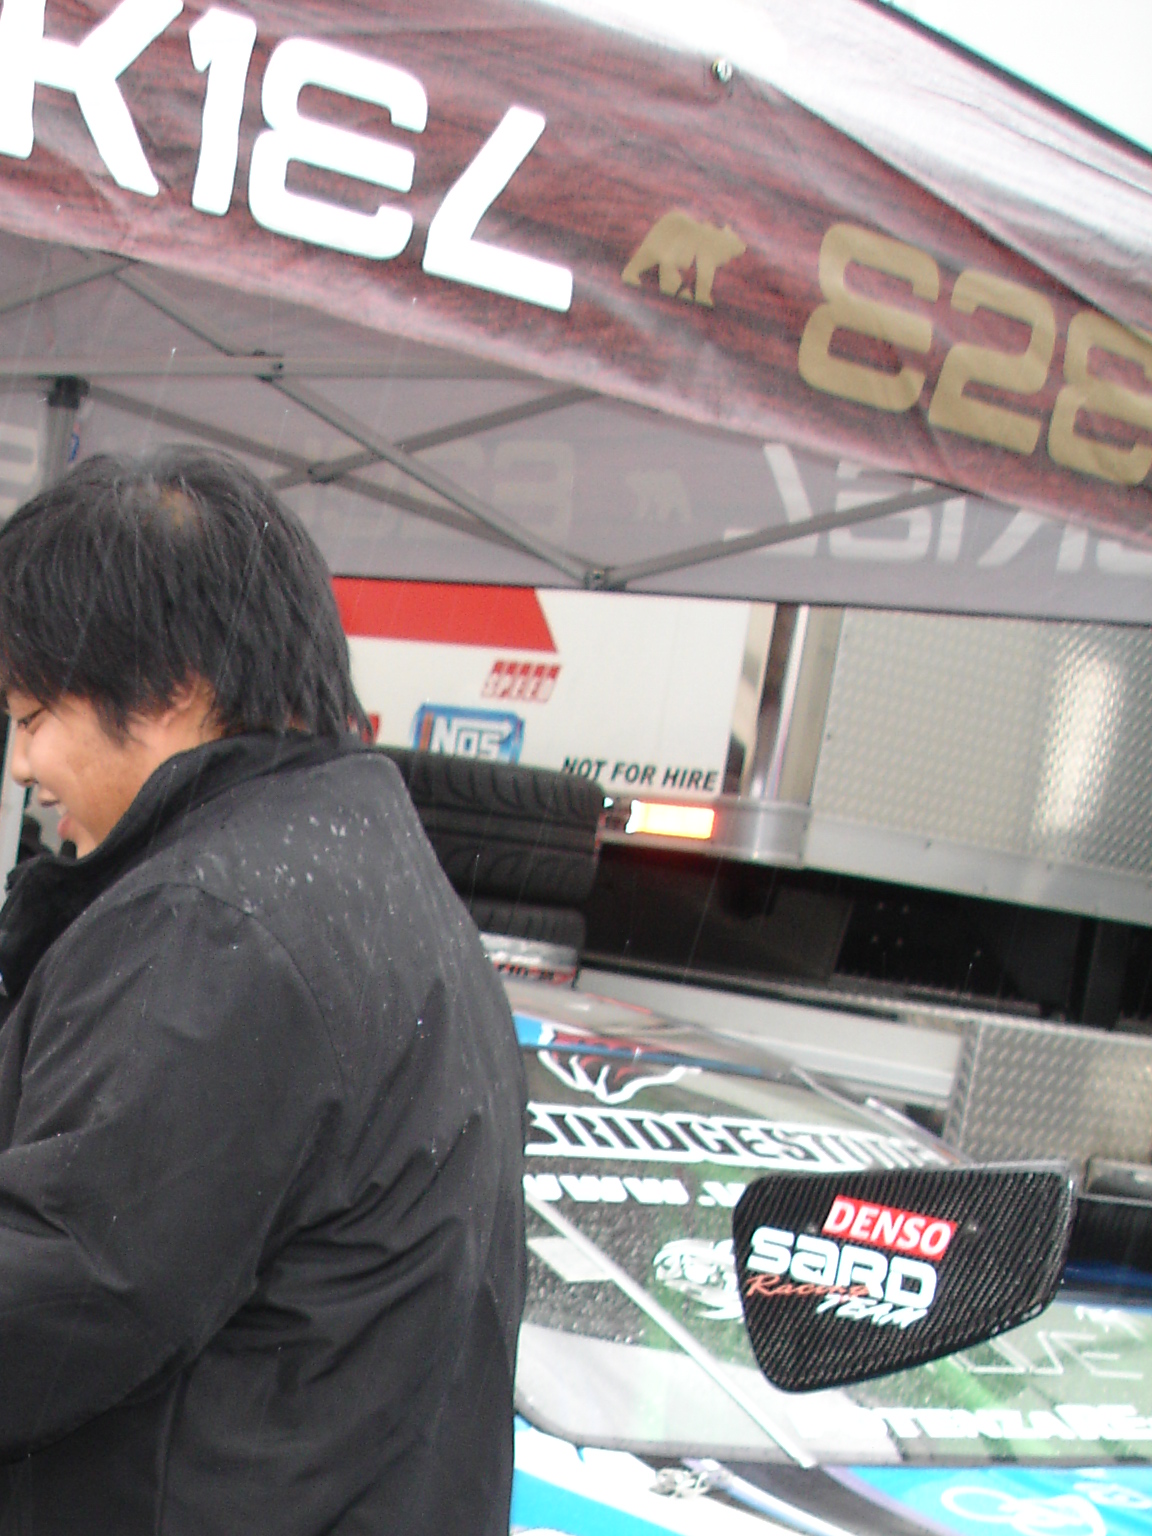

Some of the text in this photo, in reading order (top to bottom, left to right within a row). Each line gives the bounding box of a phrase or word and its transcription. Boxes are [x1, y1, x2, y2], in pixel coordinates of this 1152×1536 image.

[430, 715, 510, 757] NOS
[560, 756, 720, 792] NOT FOR HIRE
[823, 1200, 953, 1256] DENSO
